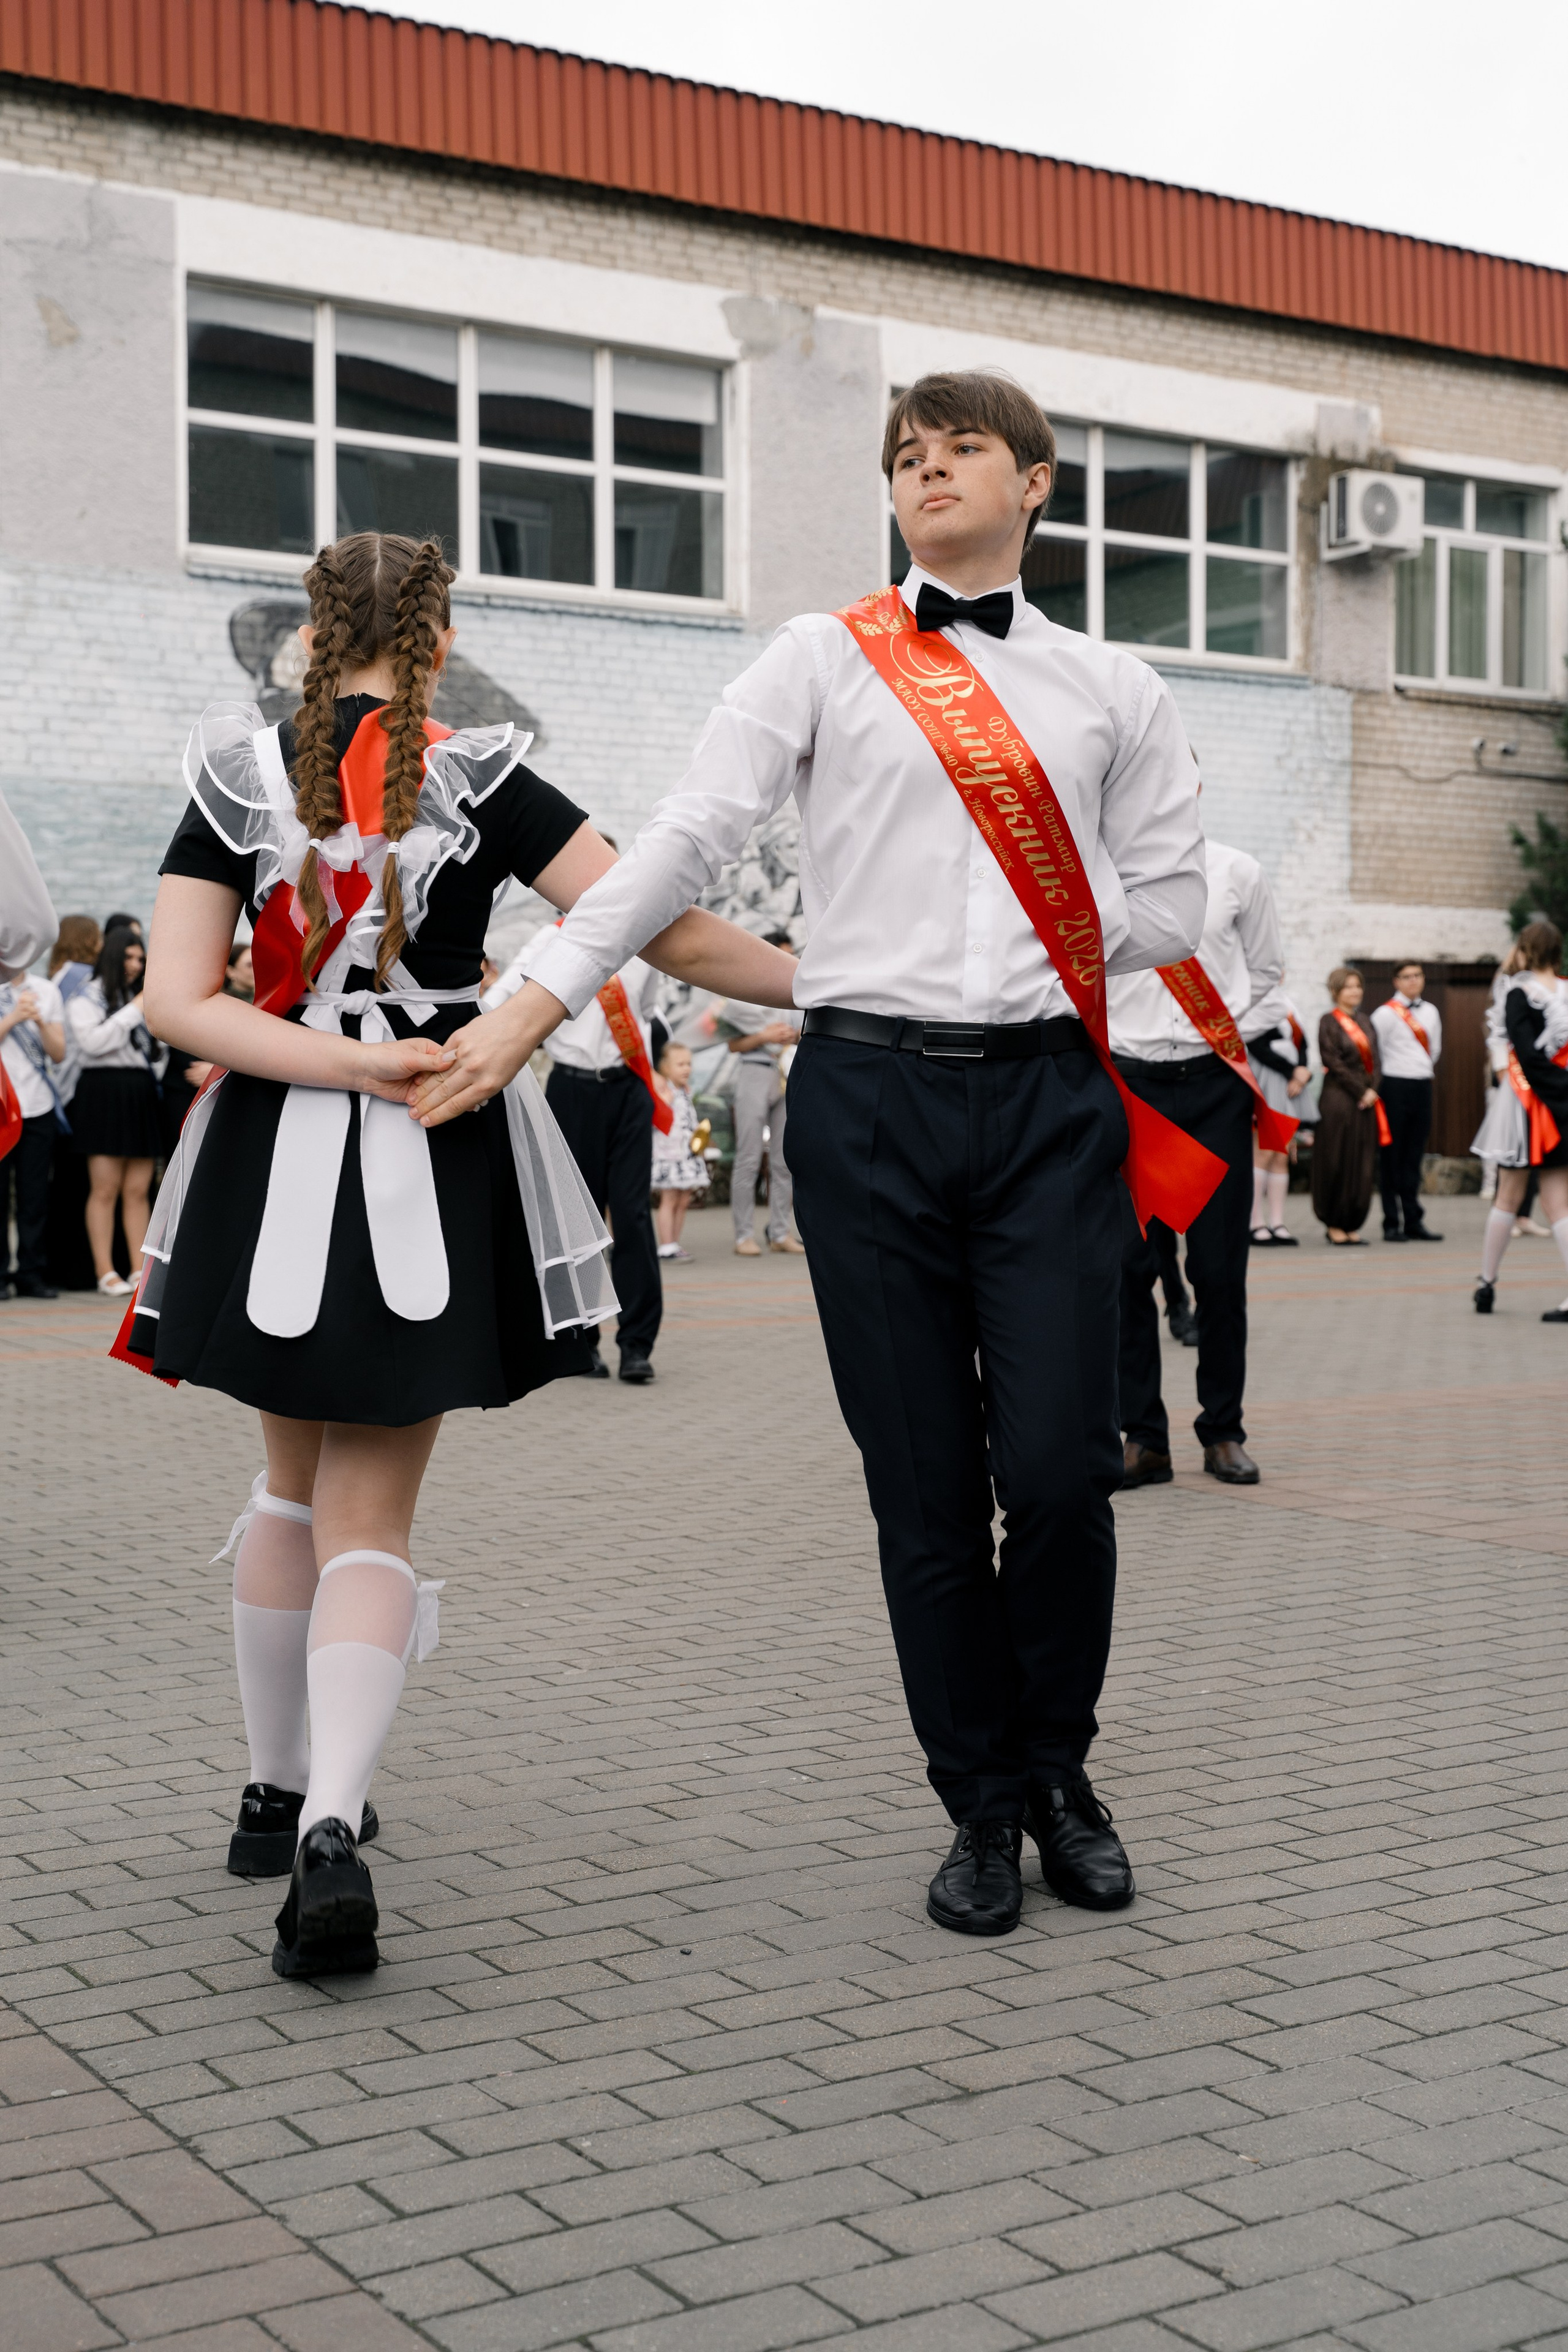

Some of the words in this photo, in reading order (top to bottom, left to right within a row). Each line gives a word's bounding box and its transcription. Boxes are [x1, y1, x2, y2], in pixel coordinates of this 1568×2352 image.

[889, 628, 1069, 905] Выпускник
[1054, 911, 1103, 986] 2026
[891, 677, 926, 711] МАОУ
[917, 713, 944, 741] СОШ
[935, 741, 958, 766] №40
[969, 797, 1014, 873] Новороссийск
[987, 716, 1043, 798] Дубровин
[1037, 799, 1076, 873] Ратмир
[1170, 963, 1210, 1012] скник
